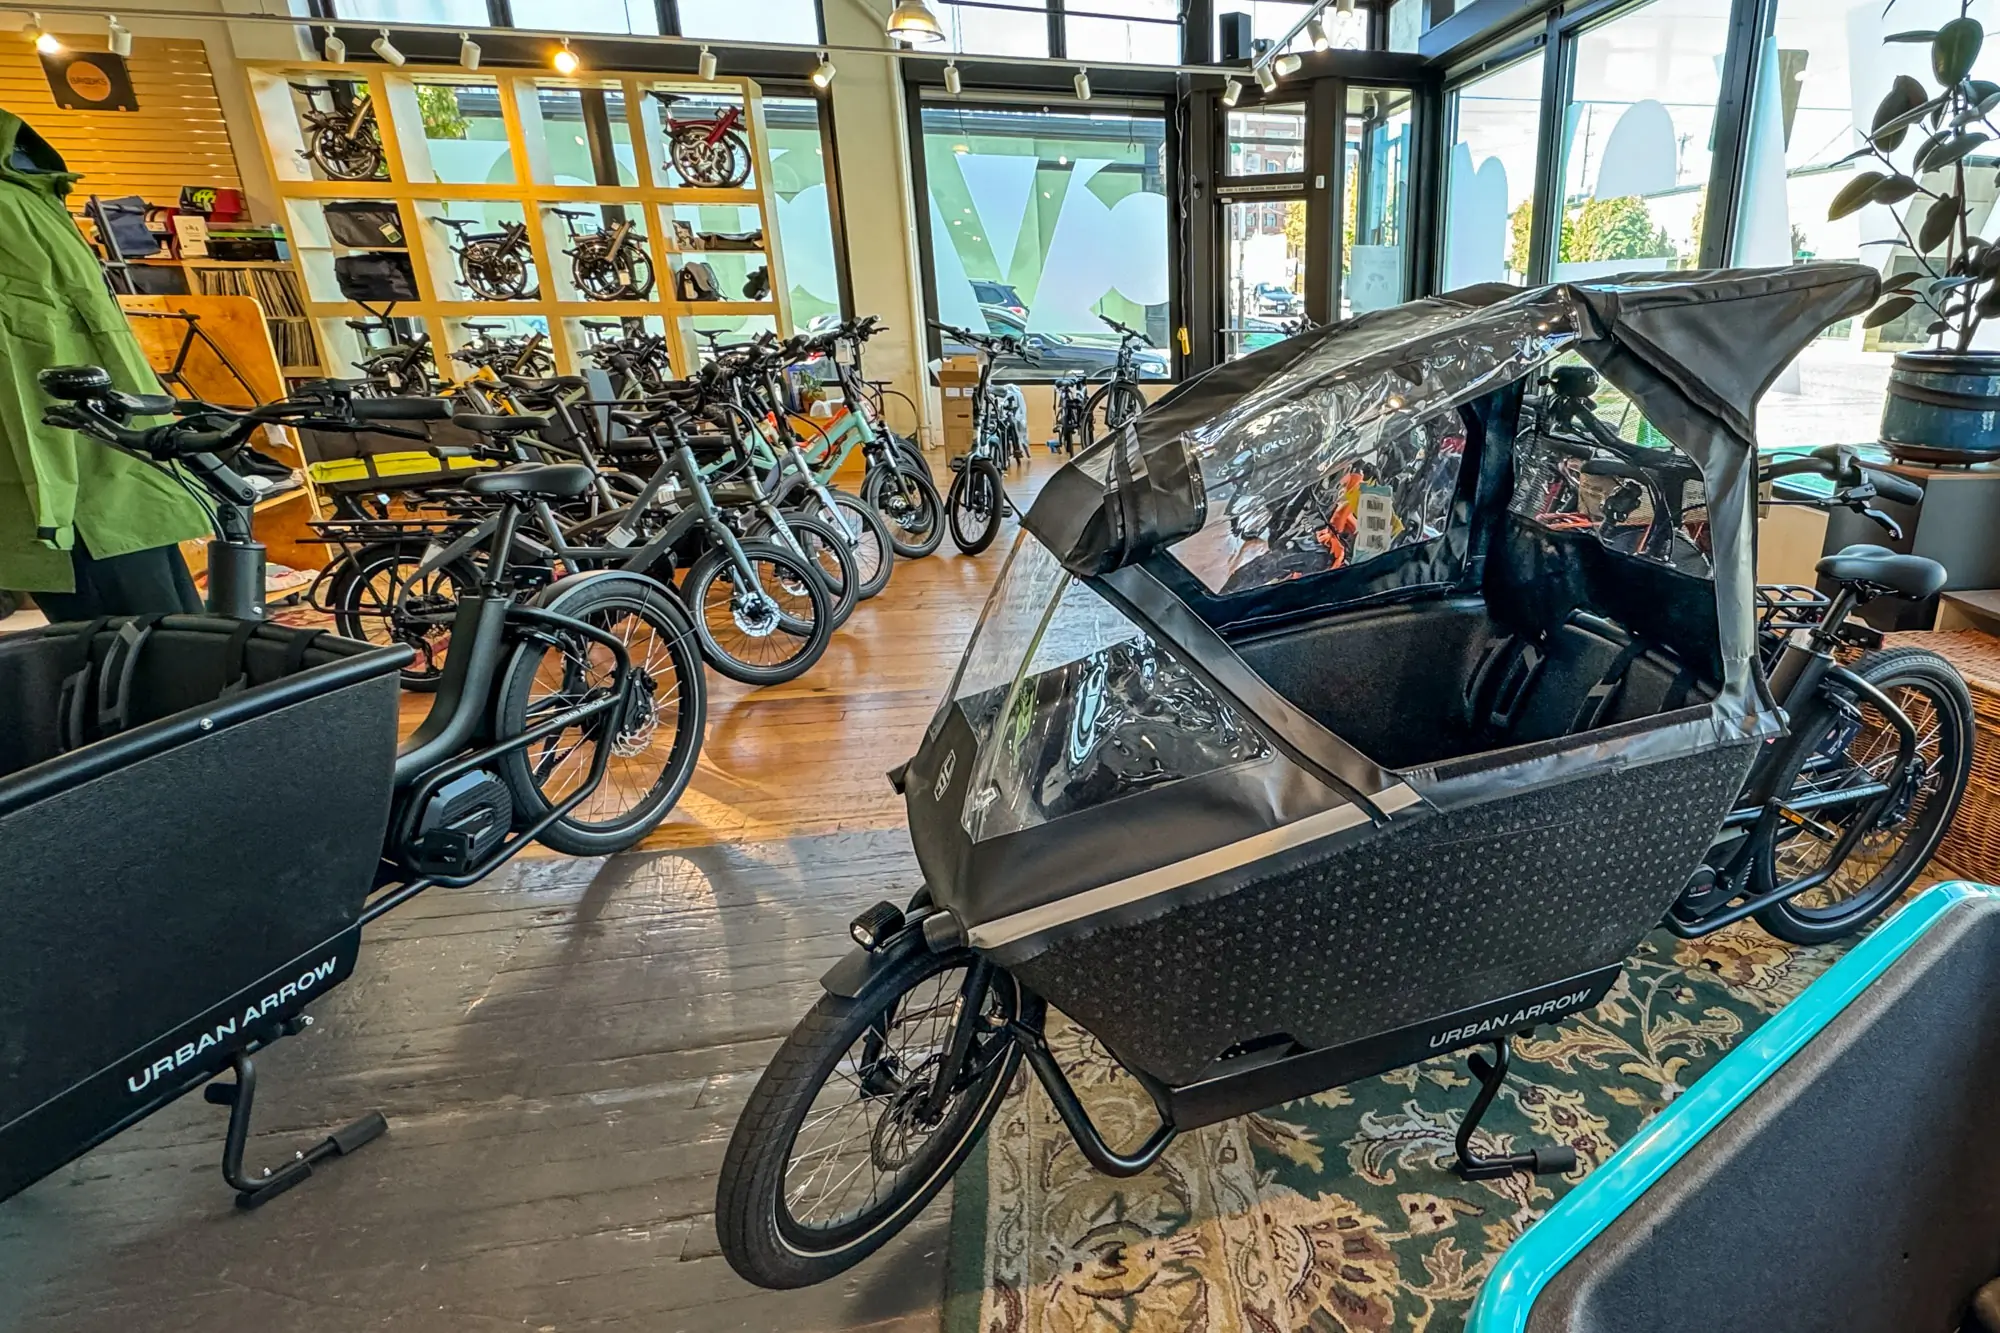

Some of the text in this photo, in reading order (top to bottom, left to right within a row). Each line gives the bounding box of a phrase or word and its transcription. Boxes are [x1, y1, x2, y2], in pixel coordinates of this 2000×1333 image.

[127, 956, 337, 1093] URBAN ARROW
[1429, 988, 1591, 1048] URBAN ARROW
